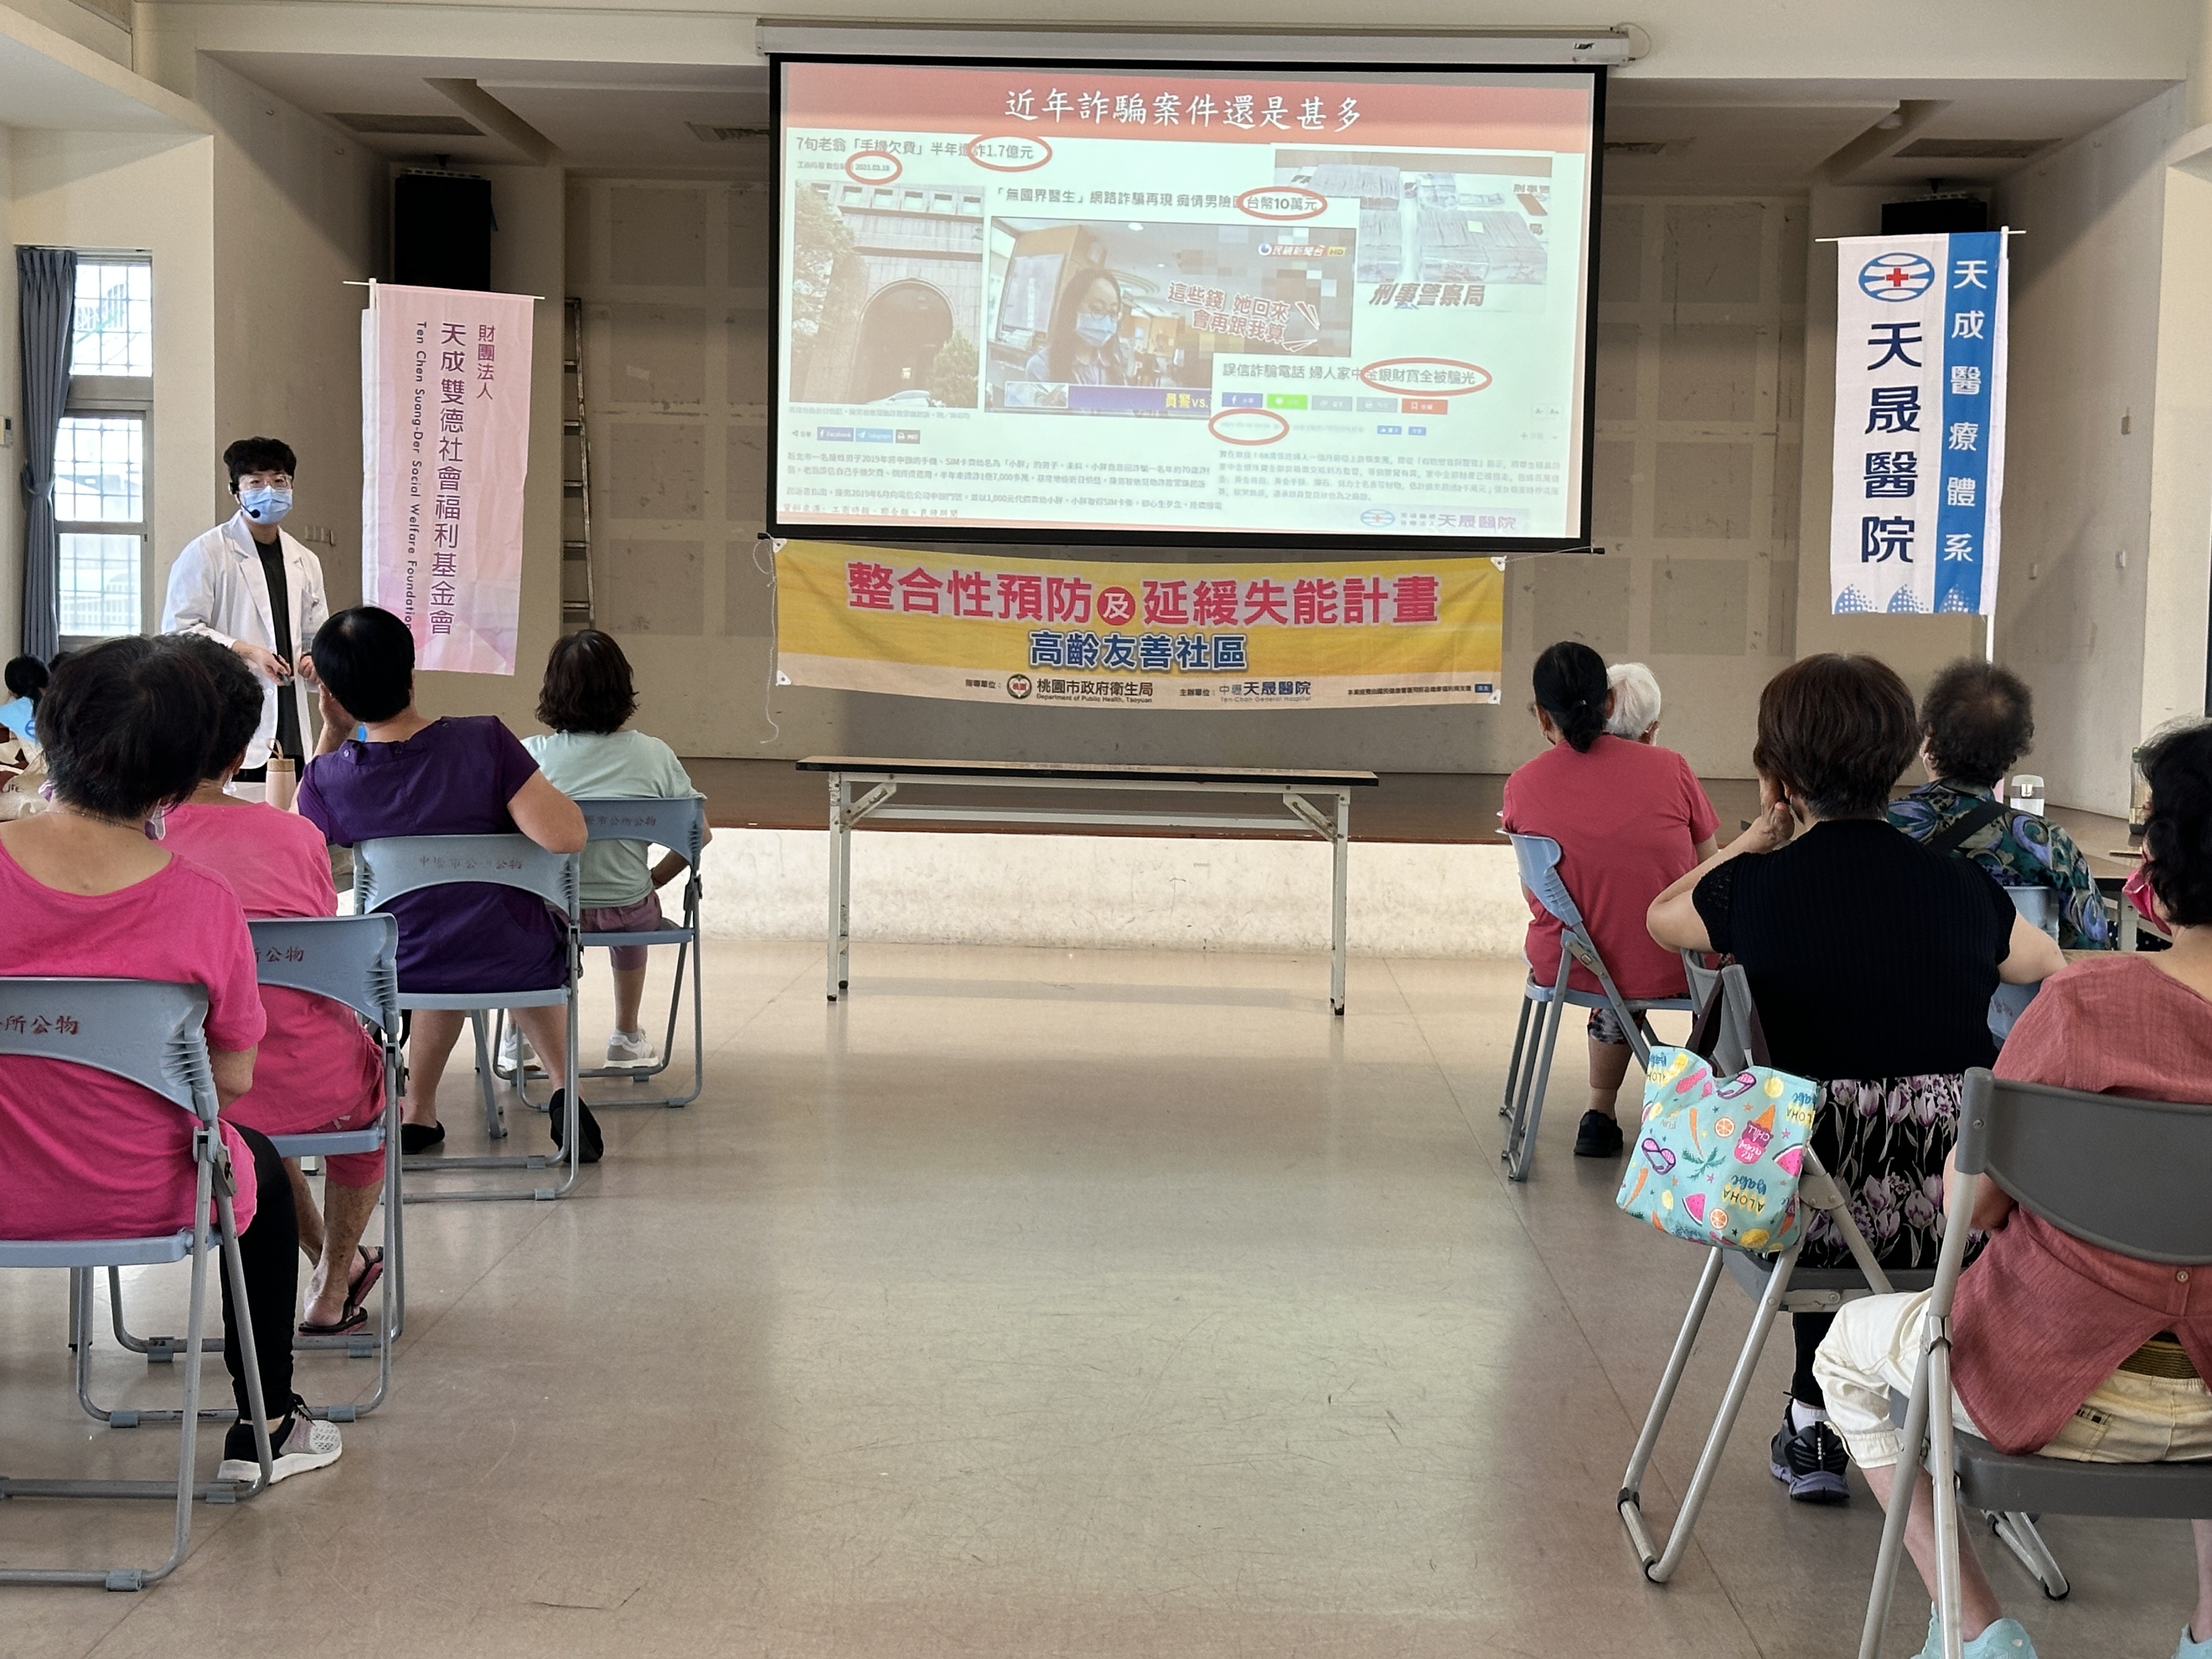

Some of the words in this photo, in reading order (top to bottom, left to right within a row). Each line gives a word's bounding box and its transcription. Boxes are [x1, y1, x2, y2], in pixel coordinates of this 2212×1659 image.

[1005, 88, 1361, 132] 近年詐騙案件還是甚多
[1167, 281, 1225, 310] 這些錢
[1234, 293, 1291, 323] 她回來
[1369, 283, 1486, 307] 刑事警察局
[416, 321, 427, 344] Ten
[1192, 308, 1286, 344] 會再跟我算
[415, 350, 427, 382] Chen
[477, 324, 496, 400] 財團法人
[411, 388, 425, 454] Suang-Der
[1943, 259, 1988, 562] 天成醫療體系
[1861, 321, 1922, 563] 天晟醫院
[410, 460, 422, 497] Social
[429, 321, 466, 635] 天成雙德社會福利基金會
[408, 503, 420, 554] Welfare
[1030, 630, 1246, 669] 高齡友善社區
[1036, 678, 1153, 697] 桃園市政府衛生局
[1036, 693, 1071, 701] Department
[1126, 696, 1153, 704] Taoyuan
[1748, 1124, 1770, 1142] CHILL
[1722, 1187, 1765, 1213] ALOHA
